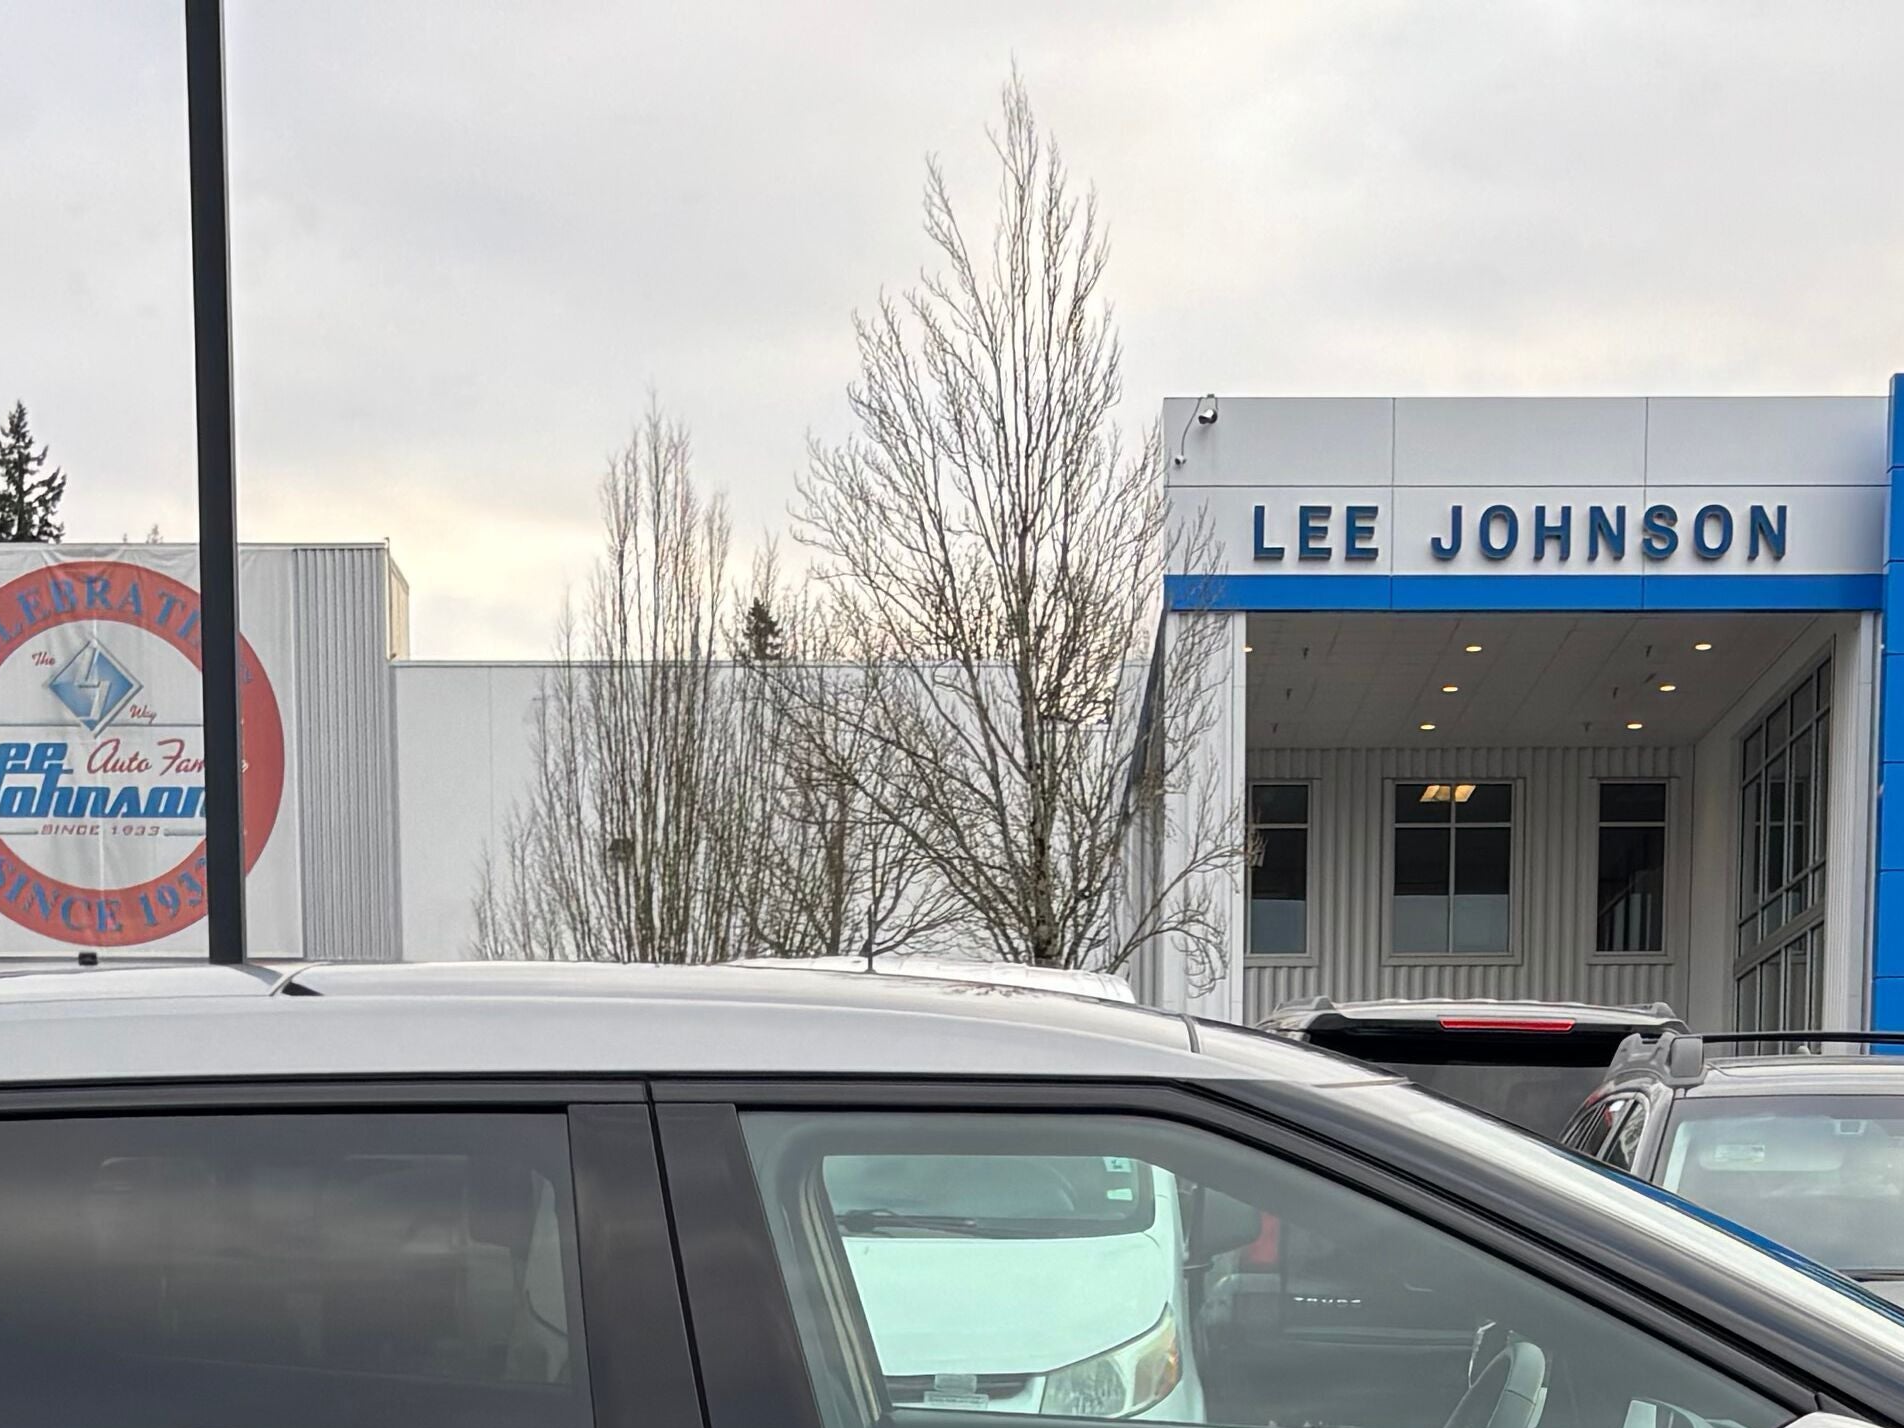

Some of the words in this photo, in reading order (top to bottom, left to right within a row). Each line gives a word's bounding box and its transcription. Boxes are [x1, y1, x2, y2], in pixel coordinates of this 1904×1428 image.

[1252, 504, 1380, 561] LEE
[1430, 503, 1788, 562] JOHNSON
[31, 652, 56, 666] The
[86, 738, 153, 774] Auto
[40, 824, 100, 836] SINCE
[139, 856, 207, 927] 193
